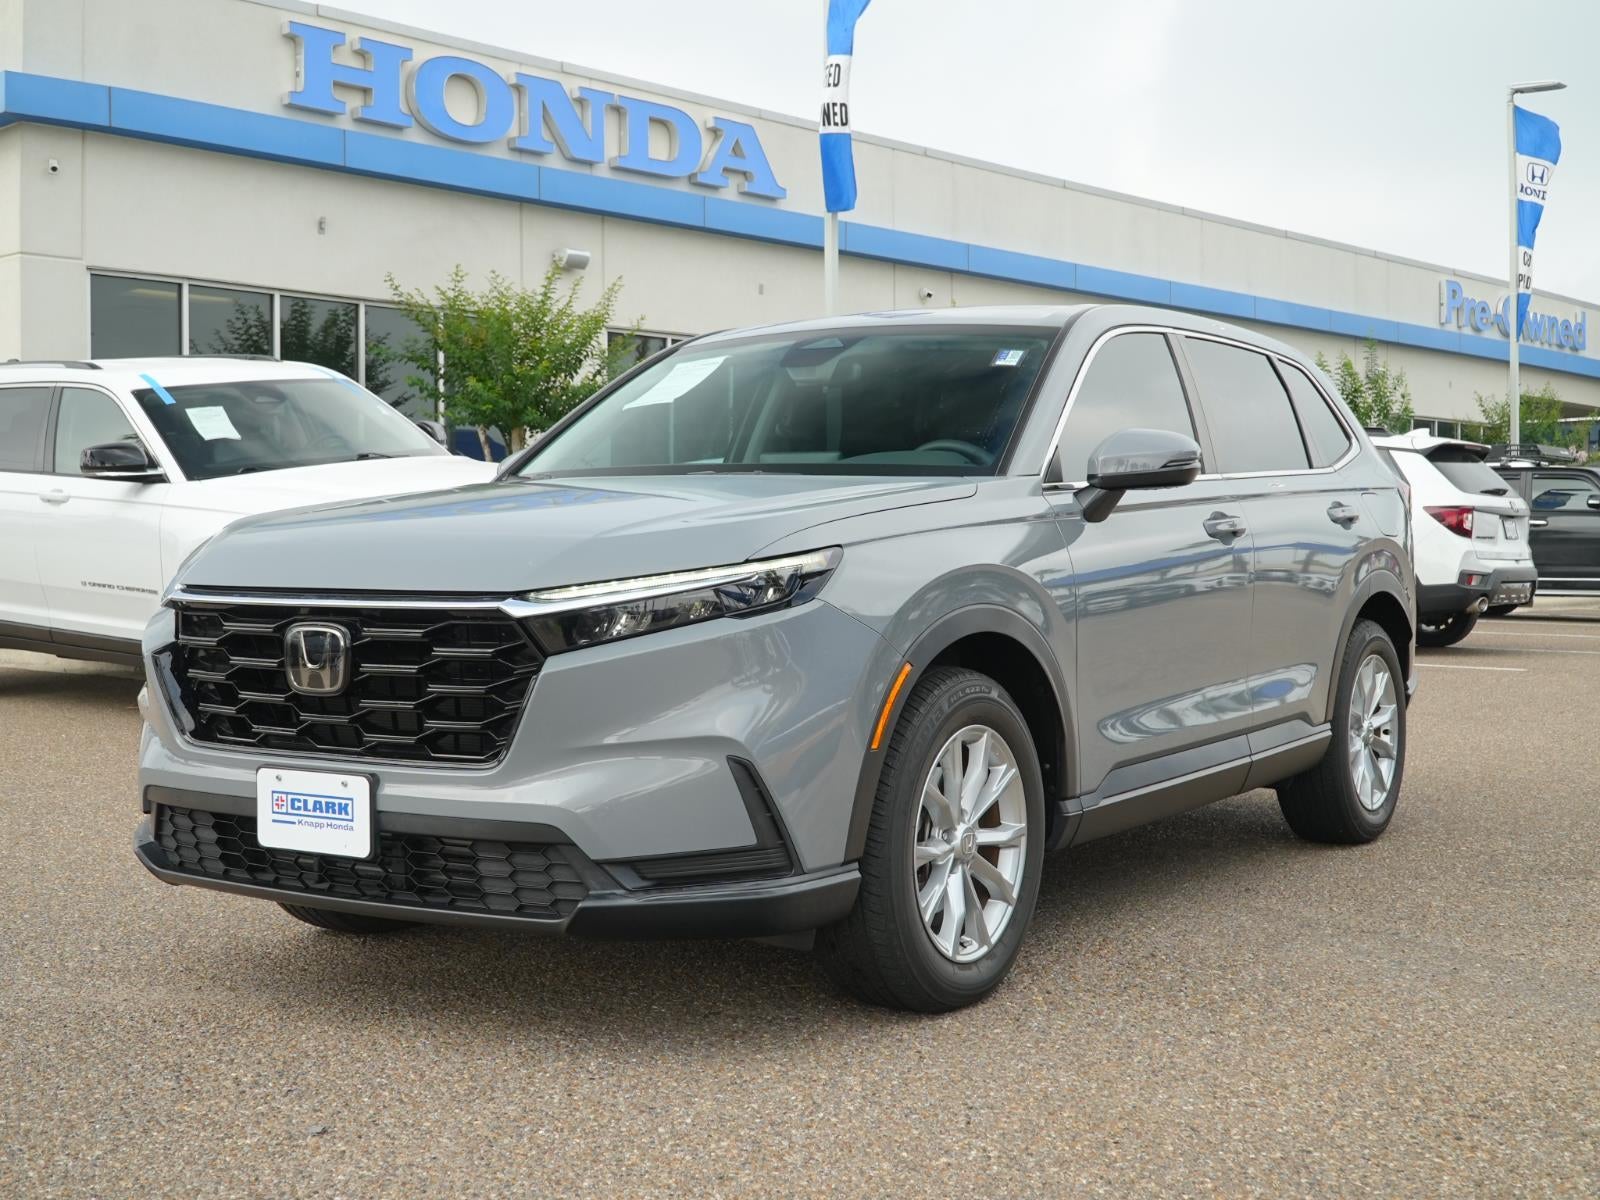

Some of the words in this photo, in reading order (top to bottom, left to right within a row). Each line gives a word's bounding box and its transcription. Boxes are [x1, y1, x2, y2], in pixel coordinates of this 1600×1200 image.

[284, 20, 787, 200] HONDA
[1440, 280, 1587, 351] Pre-wned
[290, 797, 350, 816] CLARK
[297, 818, 325, 829] Knapp
[326, 822, 354, 832] Honda
